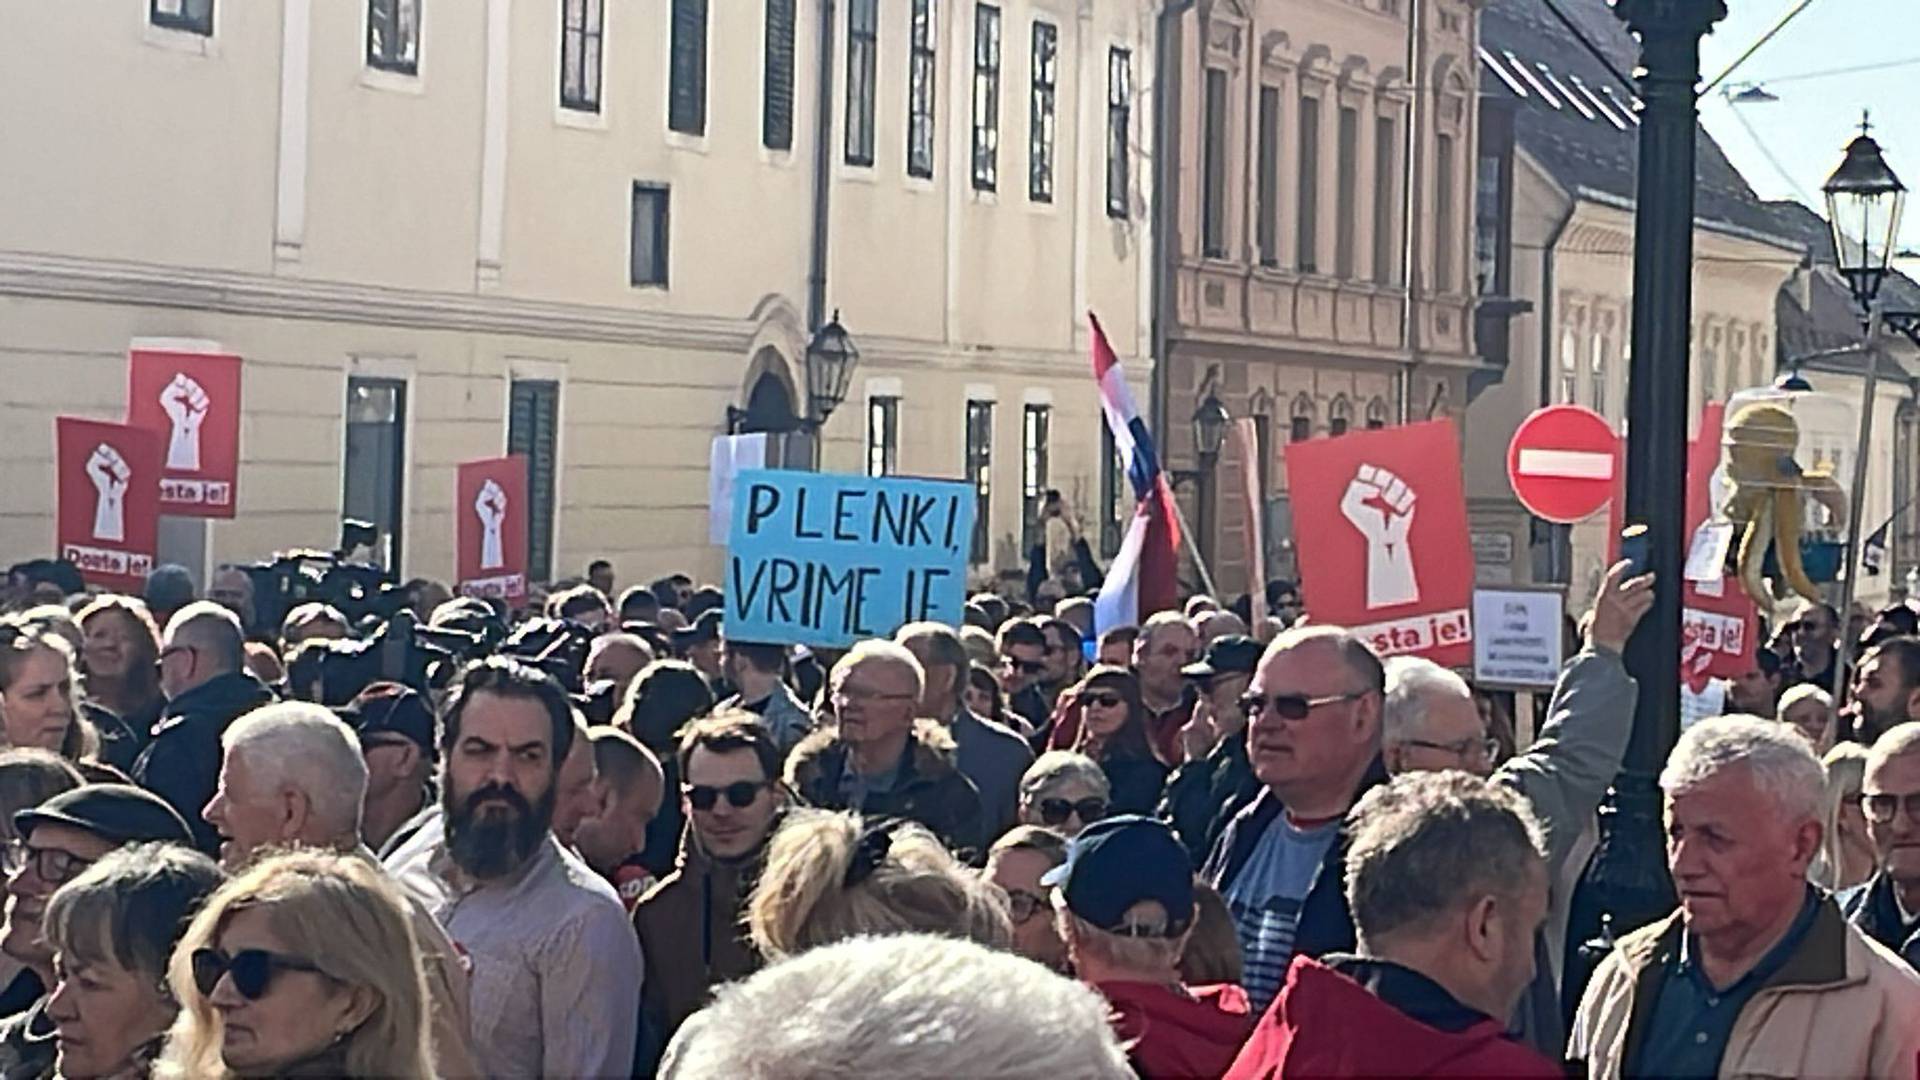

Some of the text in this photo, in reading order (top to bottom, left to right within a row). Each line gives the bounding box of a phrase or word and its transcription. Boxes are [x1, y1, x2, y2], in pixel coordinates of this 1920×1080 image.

[746, 484, 960, 555] PLENKI,
[733, 556, 882, 636] VRIME
[1370, 614, 1467, 652] sta je!
